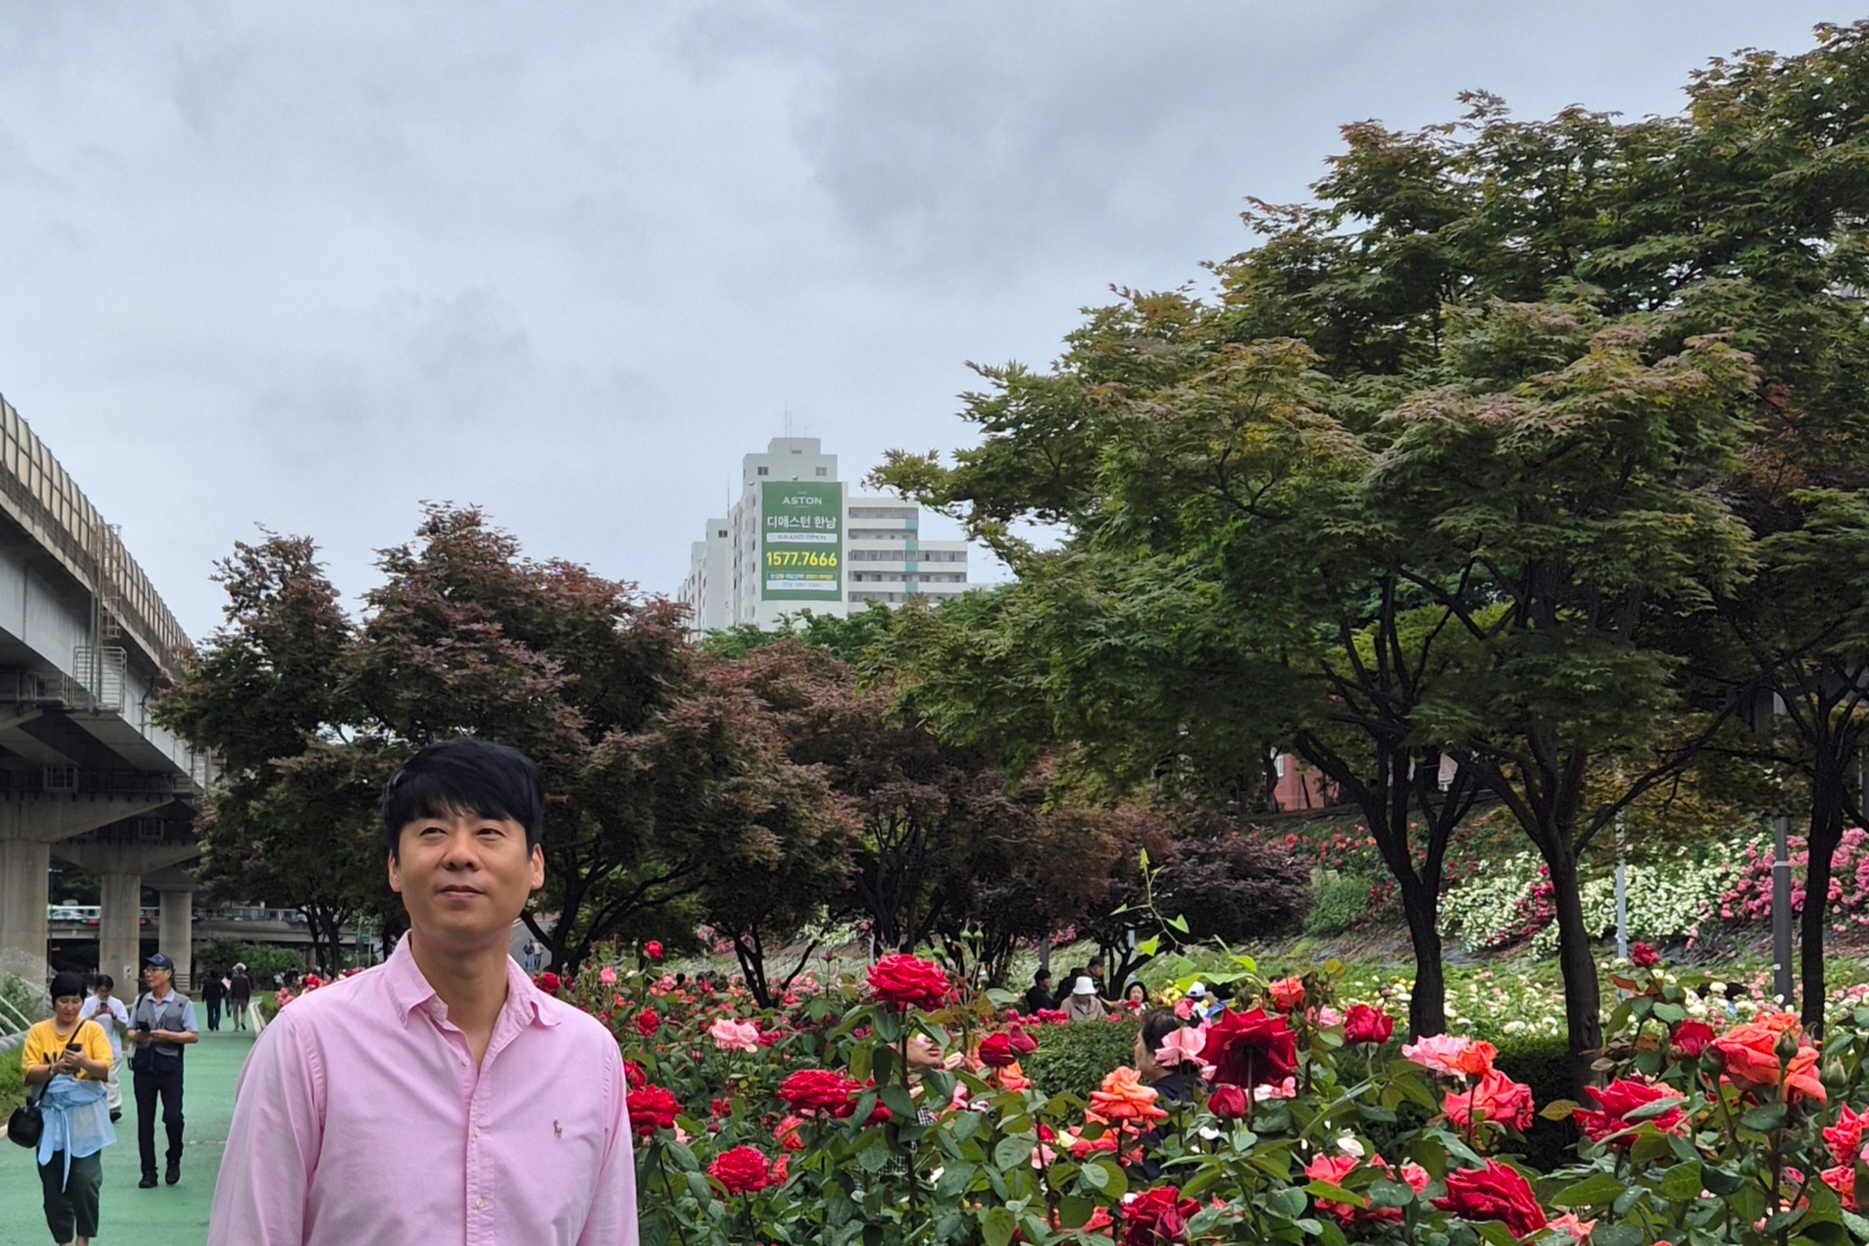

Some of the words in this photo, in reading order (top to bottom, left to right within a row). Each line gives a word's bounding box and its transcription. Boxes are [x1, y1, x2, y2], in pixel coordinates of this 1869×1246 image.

[782, 496, 822, 505] ASTON
[767, 515, 811, 528] 디애스턴
[814, 515, 836, 529] 한남
[766, 551, 837, 567] 1577.7666
